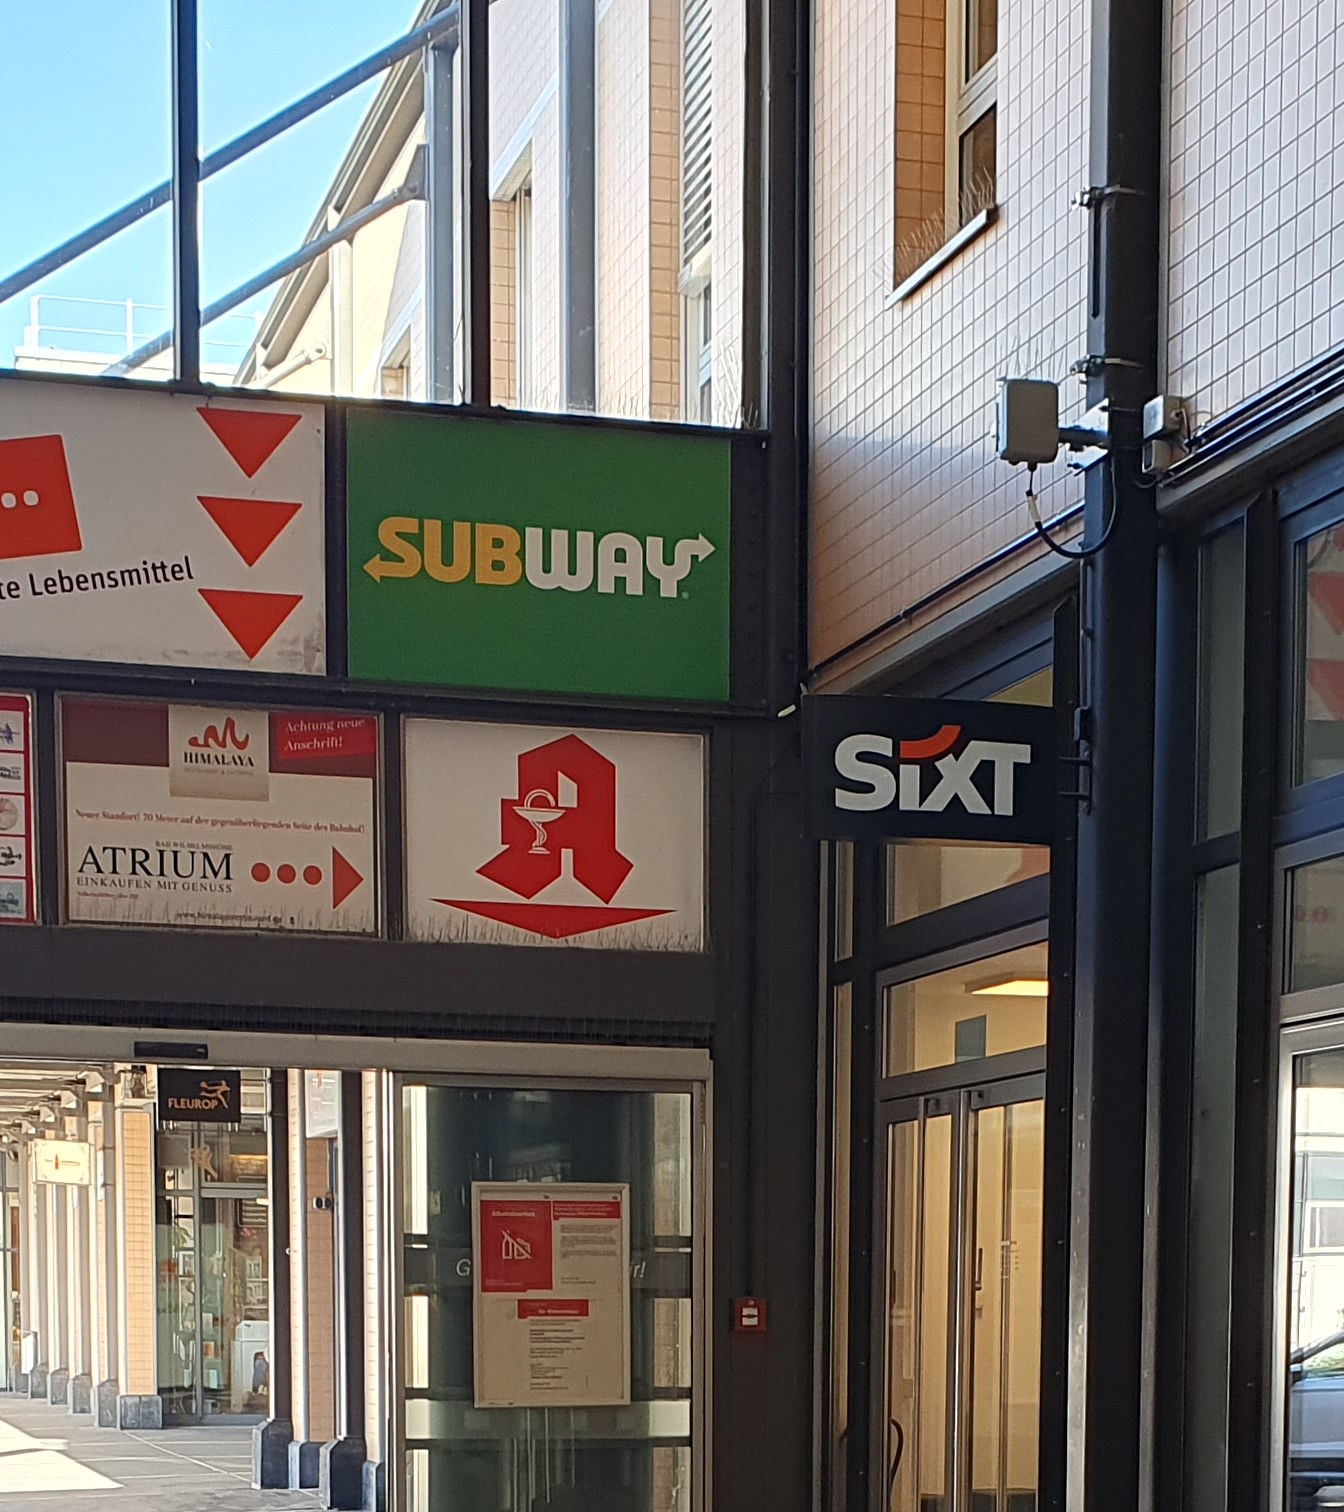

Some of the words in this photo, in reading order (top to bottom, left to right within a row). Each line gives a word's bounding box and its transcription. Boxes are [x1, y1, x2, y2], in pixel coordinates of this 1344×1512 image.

[363, 516, 716, 598] SUBWAY
[29, 556, 195, 598] Lebensmittel
[284, 719, 334, 733] Achtung
[336, 718, 366, 729] neue
[284, 736, 343, 751] Anschrift!
[184, 752, 254, 767] HIMALAYA
[77, 845, 234, 881] ATRIUM
[77, 876, 152, 889] EINKAUFEN
[157, 878, 179, 891] MIT
[181, 880, 233, 894] GENUSS
[168, 1098, 219, 1110] FLEUROP
